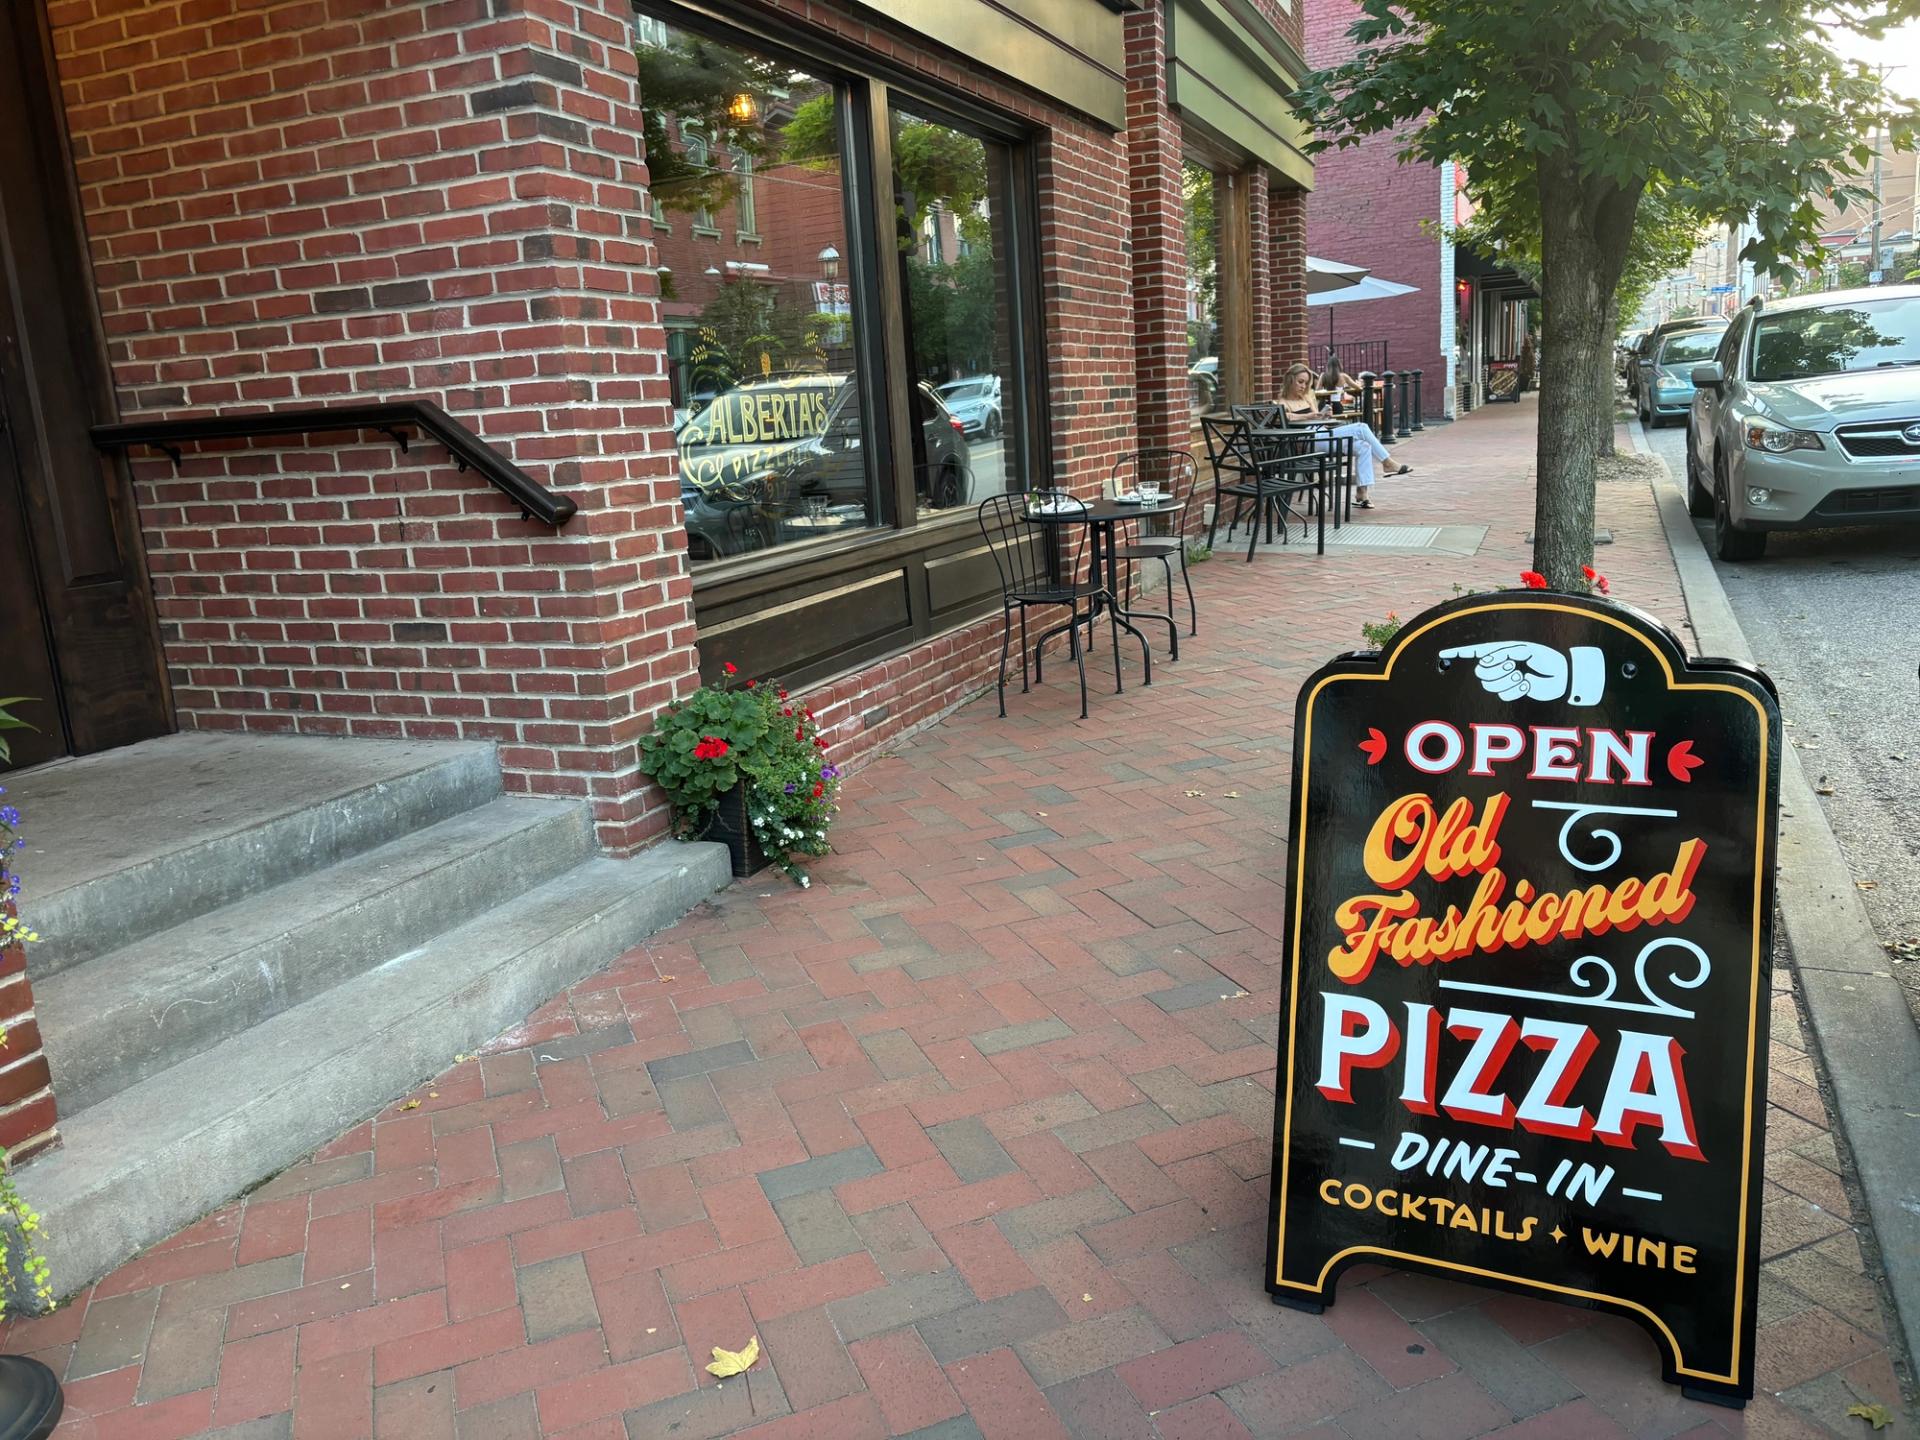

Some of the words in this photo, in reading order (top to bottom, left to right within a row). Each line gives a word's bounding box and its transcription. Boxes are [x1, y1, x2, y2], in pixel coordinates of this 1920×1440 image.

[706, 392, 829, 446] ALBERTA'S
[1404, 720, 1656, 786] OPEN
[1363, 791, 1511, 890] Old
[1327, 837, 1708, 985] Fashioned
[1315, 991, 1709, 1162] PIZZA
[1391, 1132, 1615, 1207] DINE-IN
[1319, 1178, 1539, 1242] COCKTAILS
[1582, 1227, 1698, 1274] WINE
